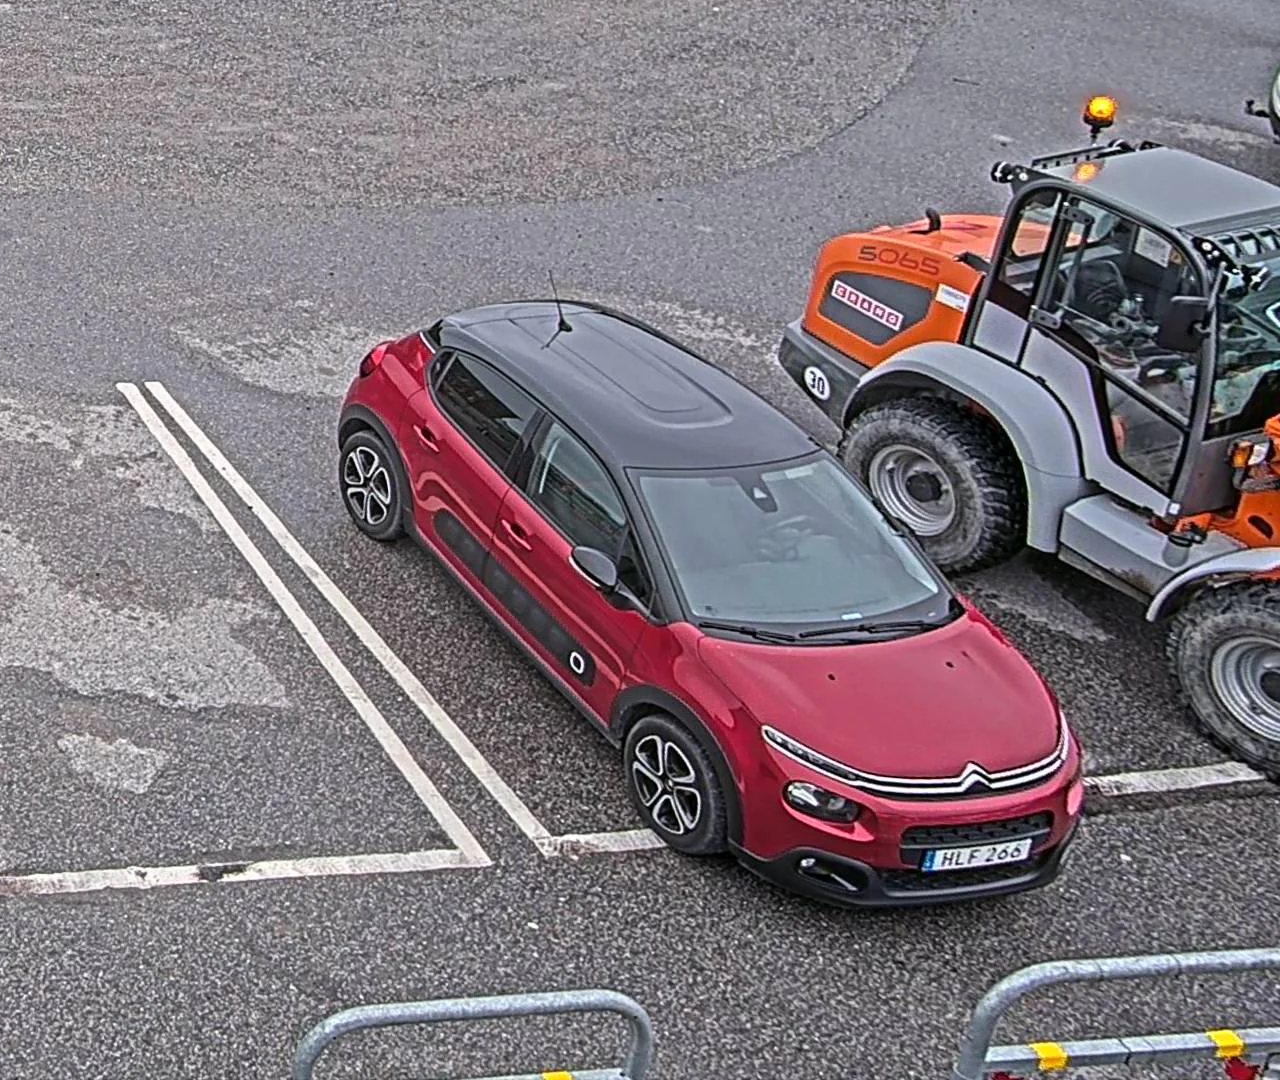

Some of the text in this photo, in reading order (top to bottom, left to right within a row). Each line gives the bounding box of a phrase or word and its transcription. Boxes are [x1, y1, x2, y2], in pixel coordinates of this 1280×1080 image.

[858, 245, 940, 276] 5065
[809, 370, 826, 395] 30
[941, 844, 1022, 867] HLF 266
